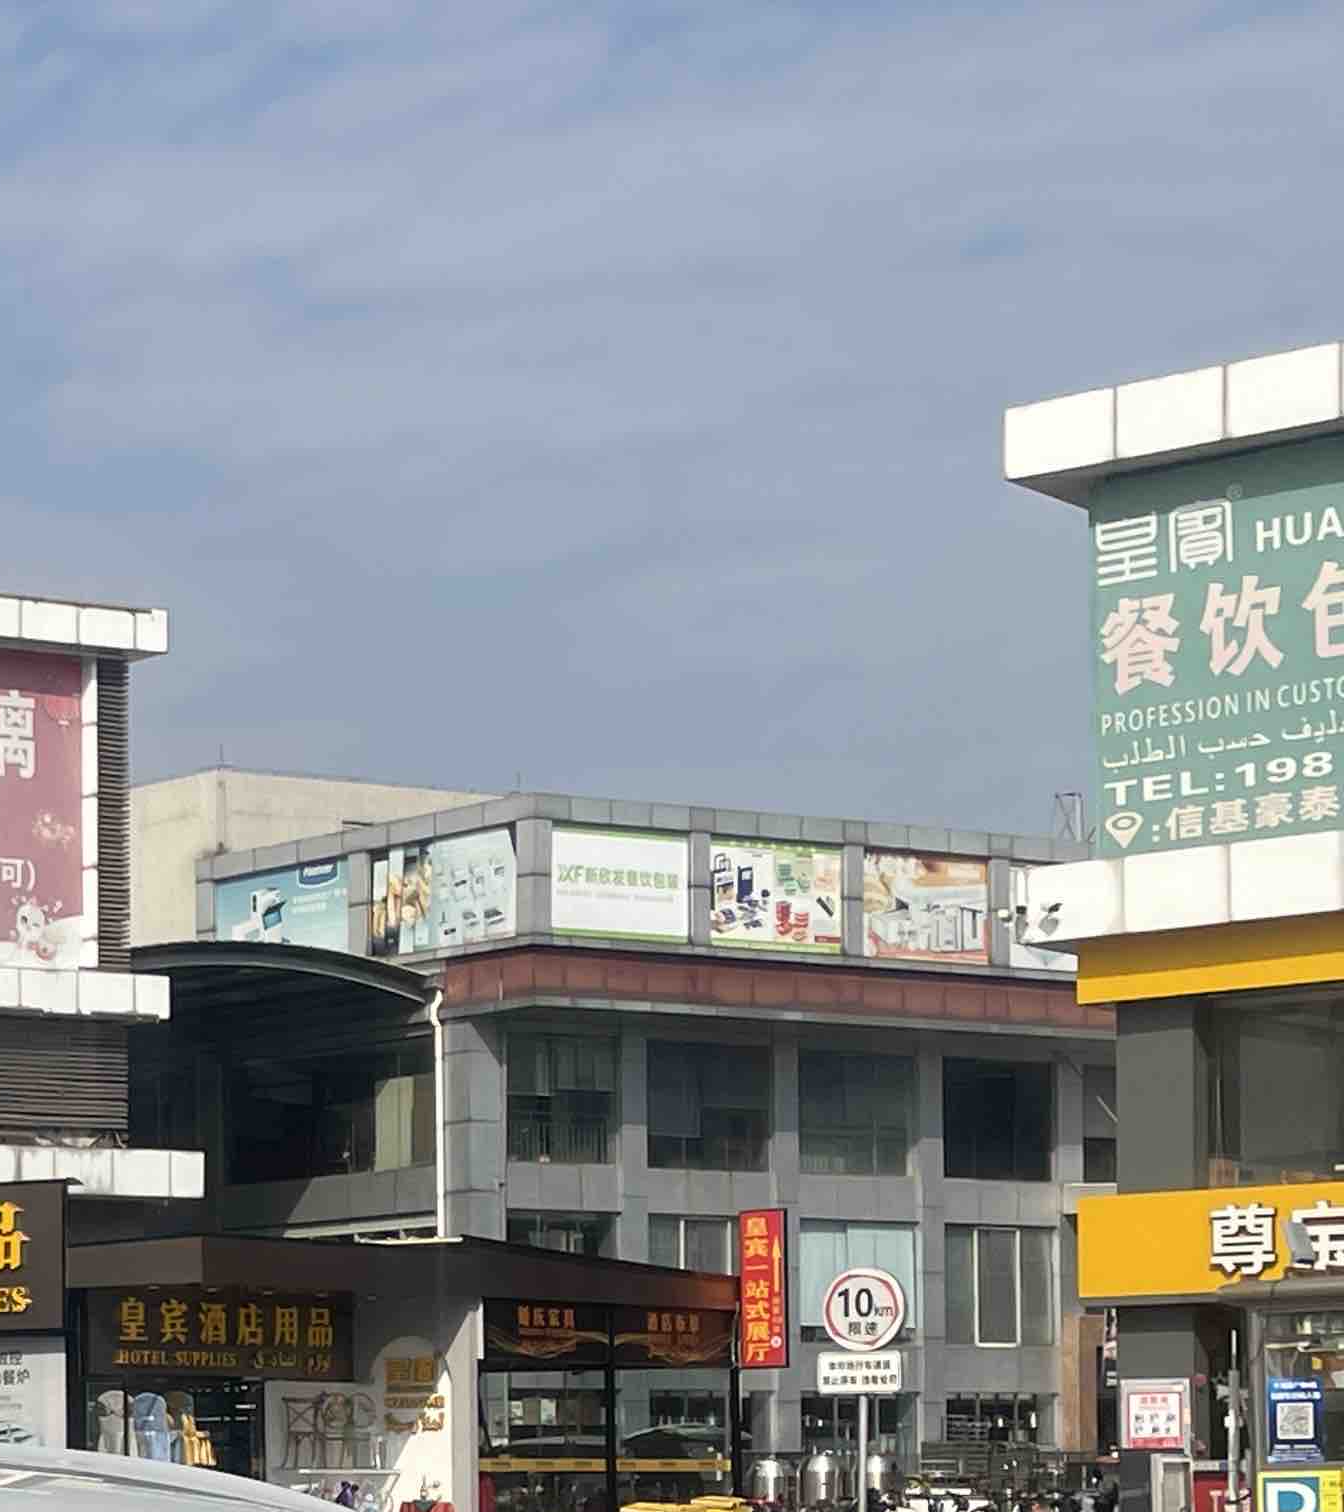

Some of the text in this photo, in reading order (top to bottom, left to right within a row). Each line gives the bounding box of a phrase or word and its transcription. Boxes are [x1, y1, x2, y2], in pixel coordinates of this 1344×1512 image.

[1101, 693, 1240, 736] PROFESSION
[1246, 687, 1271, 713] IN
[119, 1296, 334, 1347] 皇宾酒店用品
[838, 1287, 874, 1318] 10
[119, 1349, 238, 1368] HOTEL SUPPLIES
